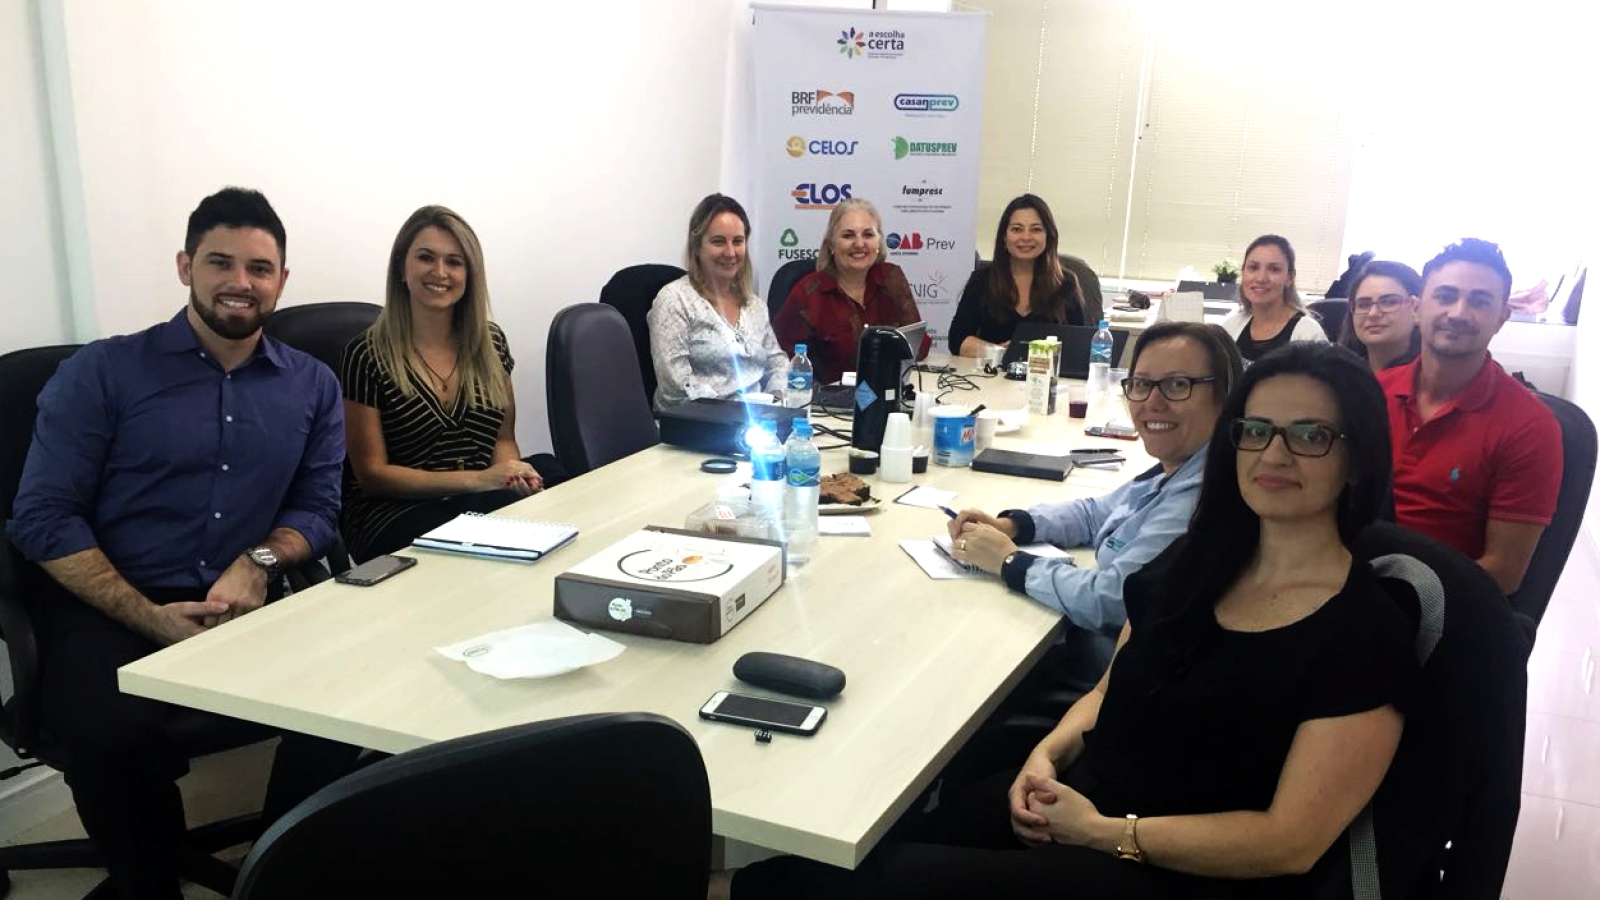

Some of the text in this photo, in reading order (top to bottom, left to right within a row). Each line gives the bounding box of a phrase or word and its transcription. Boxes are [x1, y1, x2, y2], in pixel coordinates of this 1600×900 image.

[875, 30, 905, 38] escolha
[868, 39, 904, 50] certa
[791, 91, 815, 105] BRF
[791, 103, 852, 116] previdência
[808, 140, 859, 155] CELOS
[909, 142, 957, 153] DATUSPREV
[886, 232, 956, 250] OAB Prev
[908, 283, 938, 299] VIG
